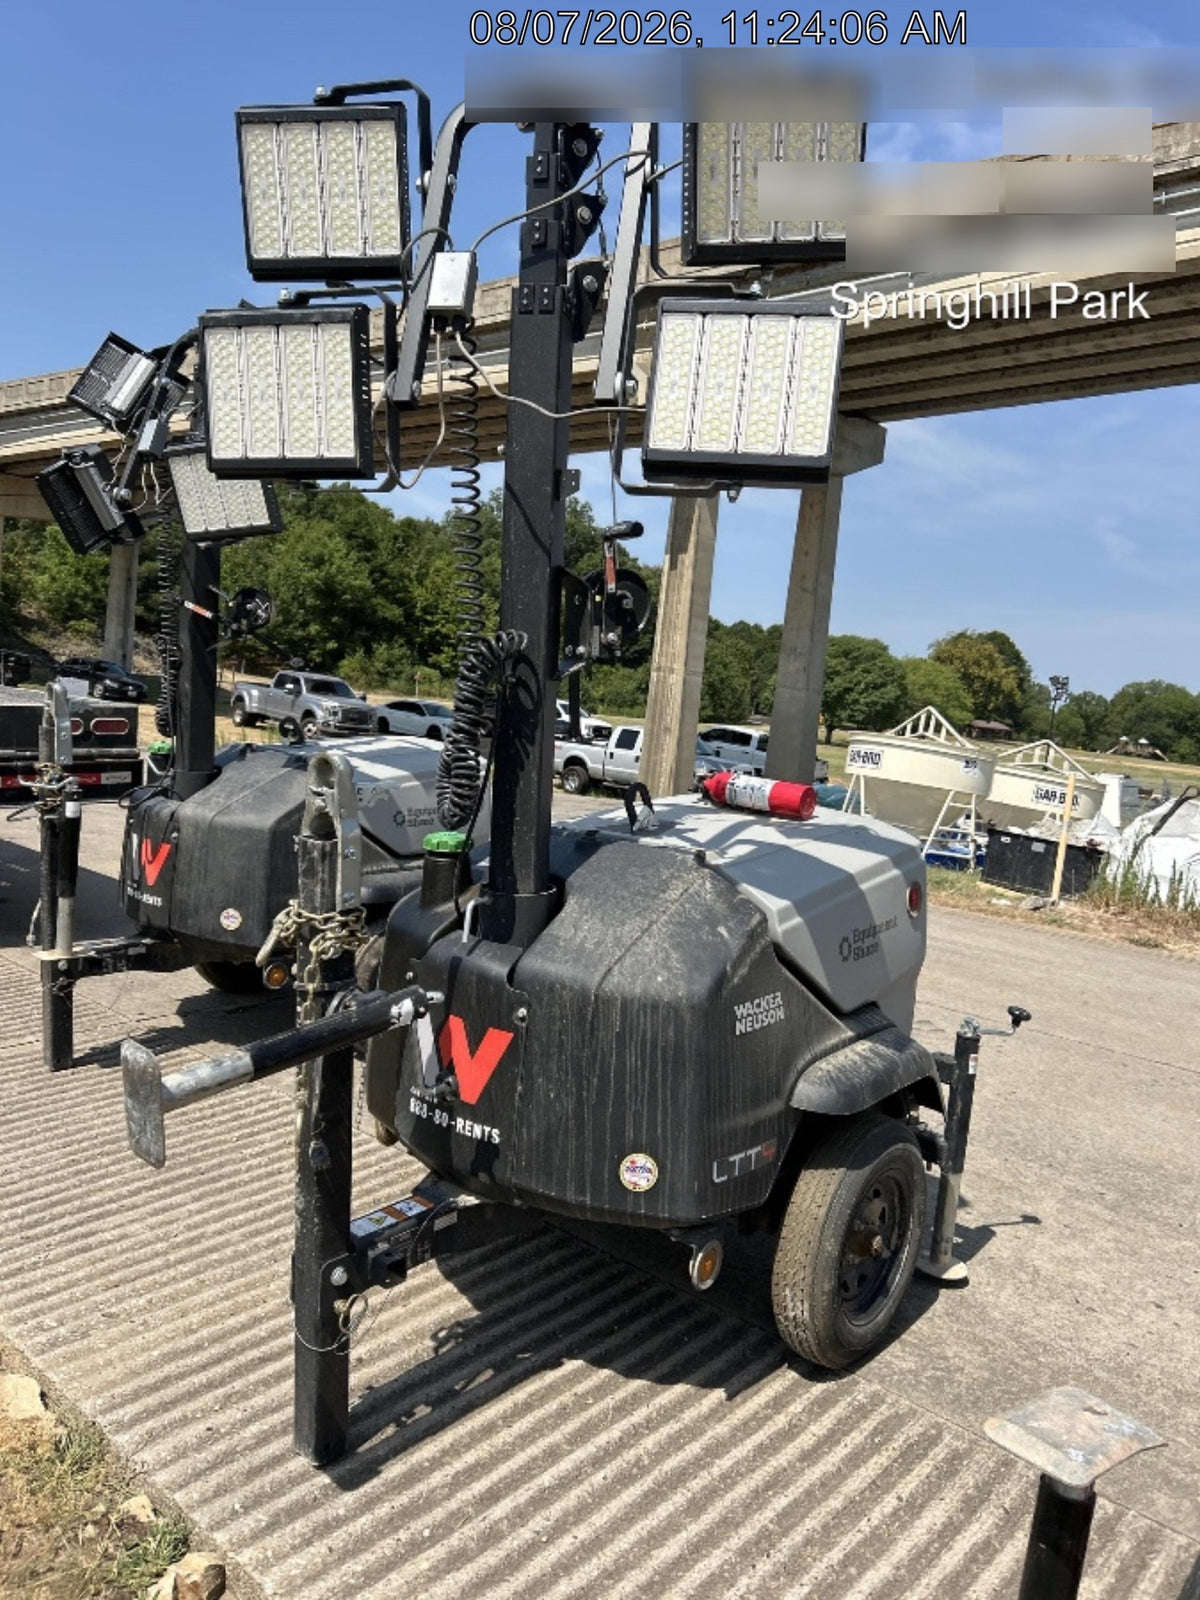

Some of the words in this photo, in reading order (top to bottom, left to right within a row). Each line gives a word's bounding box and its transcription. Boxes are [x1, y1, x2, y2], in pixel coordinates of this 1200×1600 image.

[734, 991, 783, 1019] WACKER
[736, 1005, 785, 1036] NEUSON
[409, 1097, 501, 1144] 888-80-RENTS
